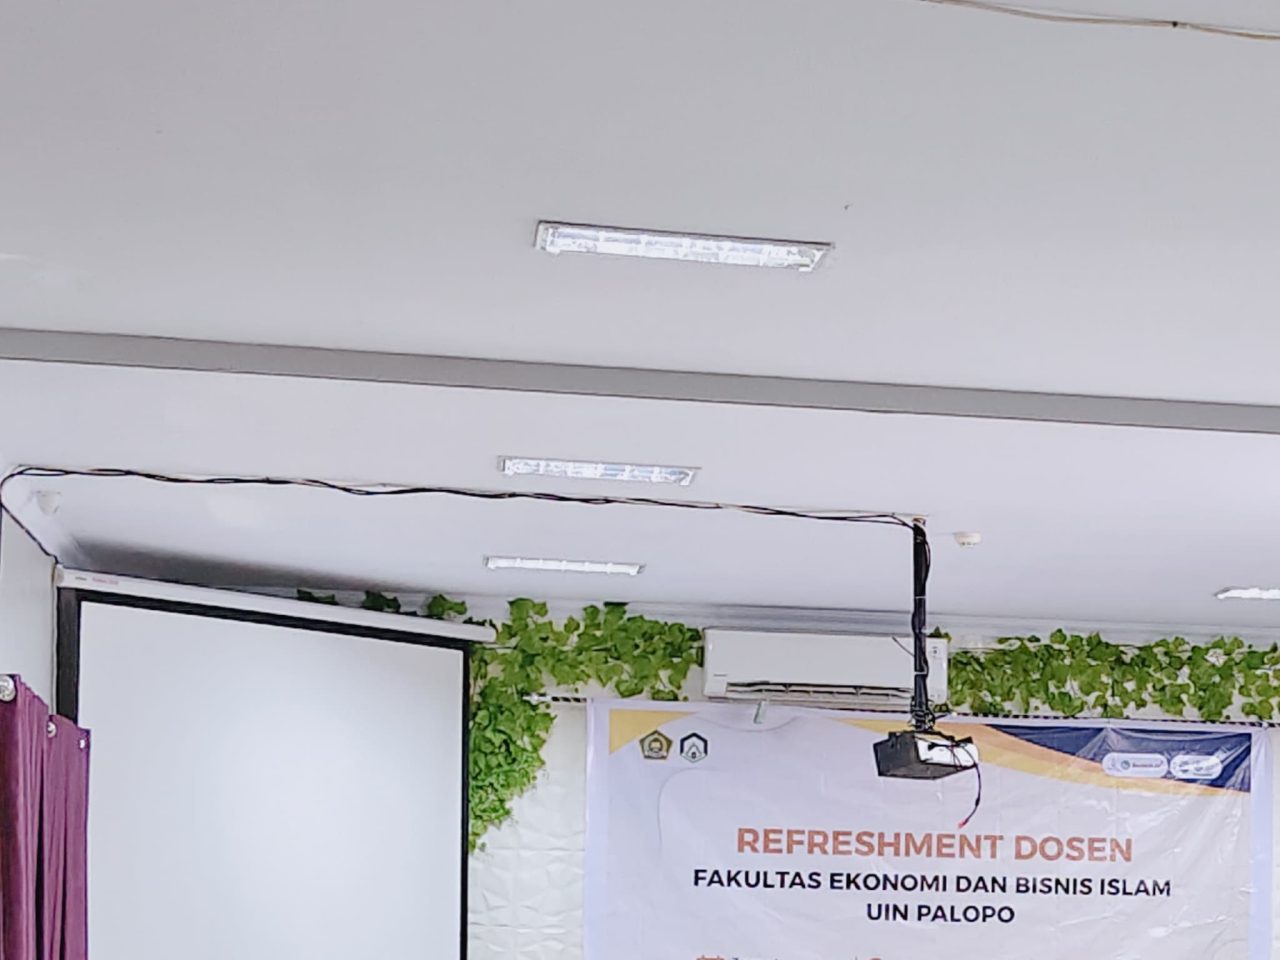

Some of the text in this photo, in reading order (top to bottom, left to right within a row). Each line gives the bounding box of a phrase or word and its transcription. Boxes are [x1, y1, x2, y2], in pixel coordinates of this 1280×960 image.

[736, 828, 1133, 863] REFRESHMENT DOSEN
[693, 869, 1172, 898] FAKULTAS EKONOMI DAN BISNIS ISLAM
[866, 903, 1016, 924] UIN PALOPO
